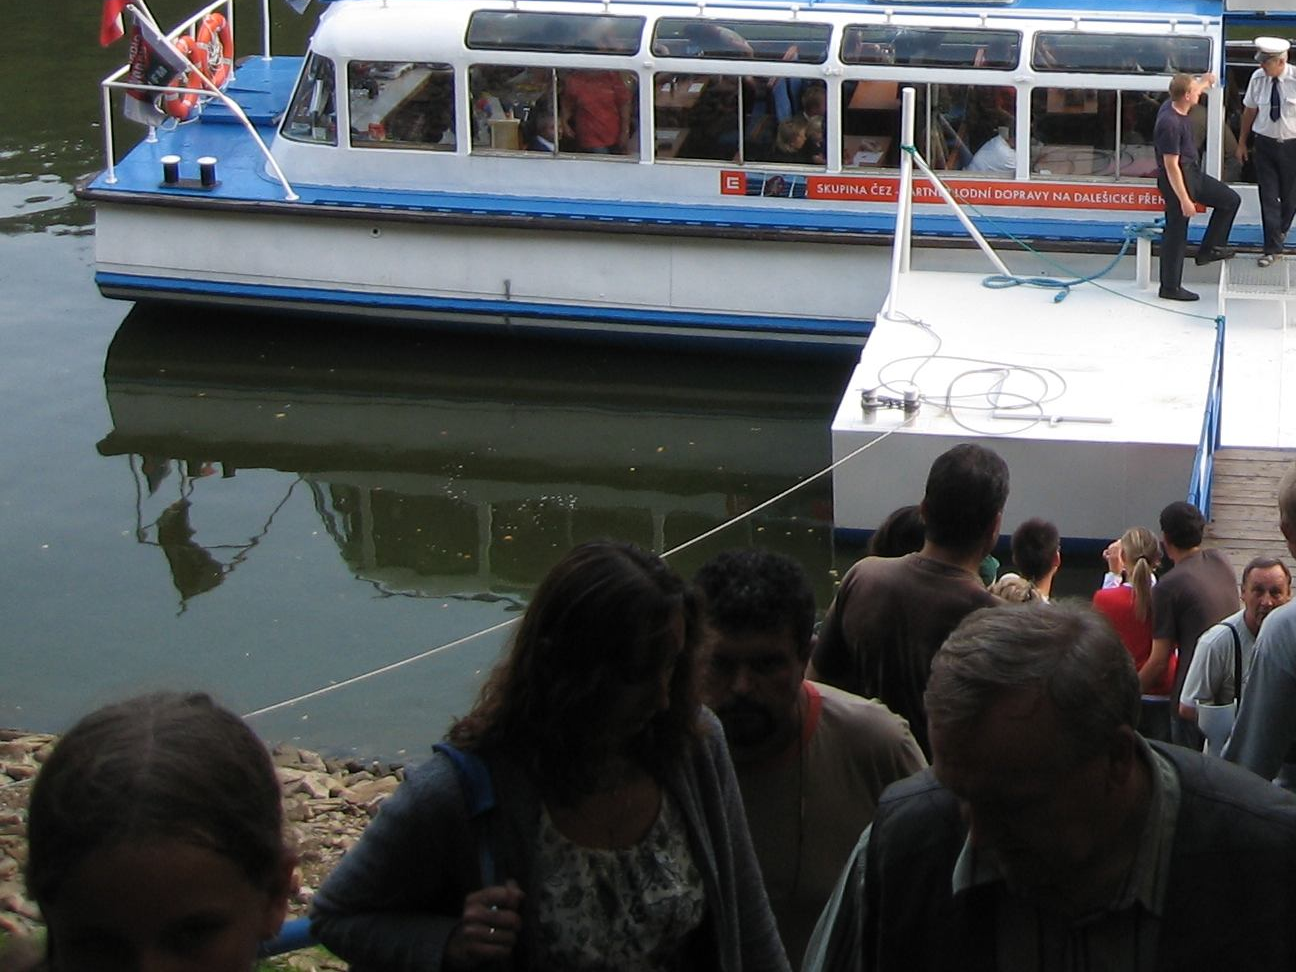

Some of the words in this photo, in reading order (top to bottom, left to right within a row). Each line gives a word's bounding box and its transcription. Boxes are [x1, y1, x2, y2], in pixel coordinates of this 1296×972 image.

[816, 182, 868, 195] SKUPINA
[870, 183, 892, 196] ČEZ
[954, 186, 991, 199] LODNÍ
[995, 189, 1050, 201] DOPRAVY
[1053, 192, 1071, 202] NA
[1074, 191, 1135, 204] DALEŠICKÉ
